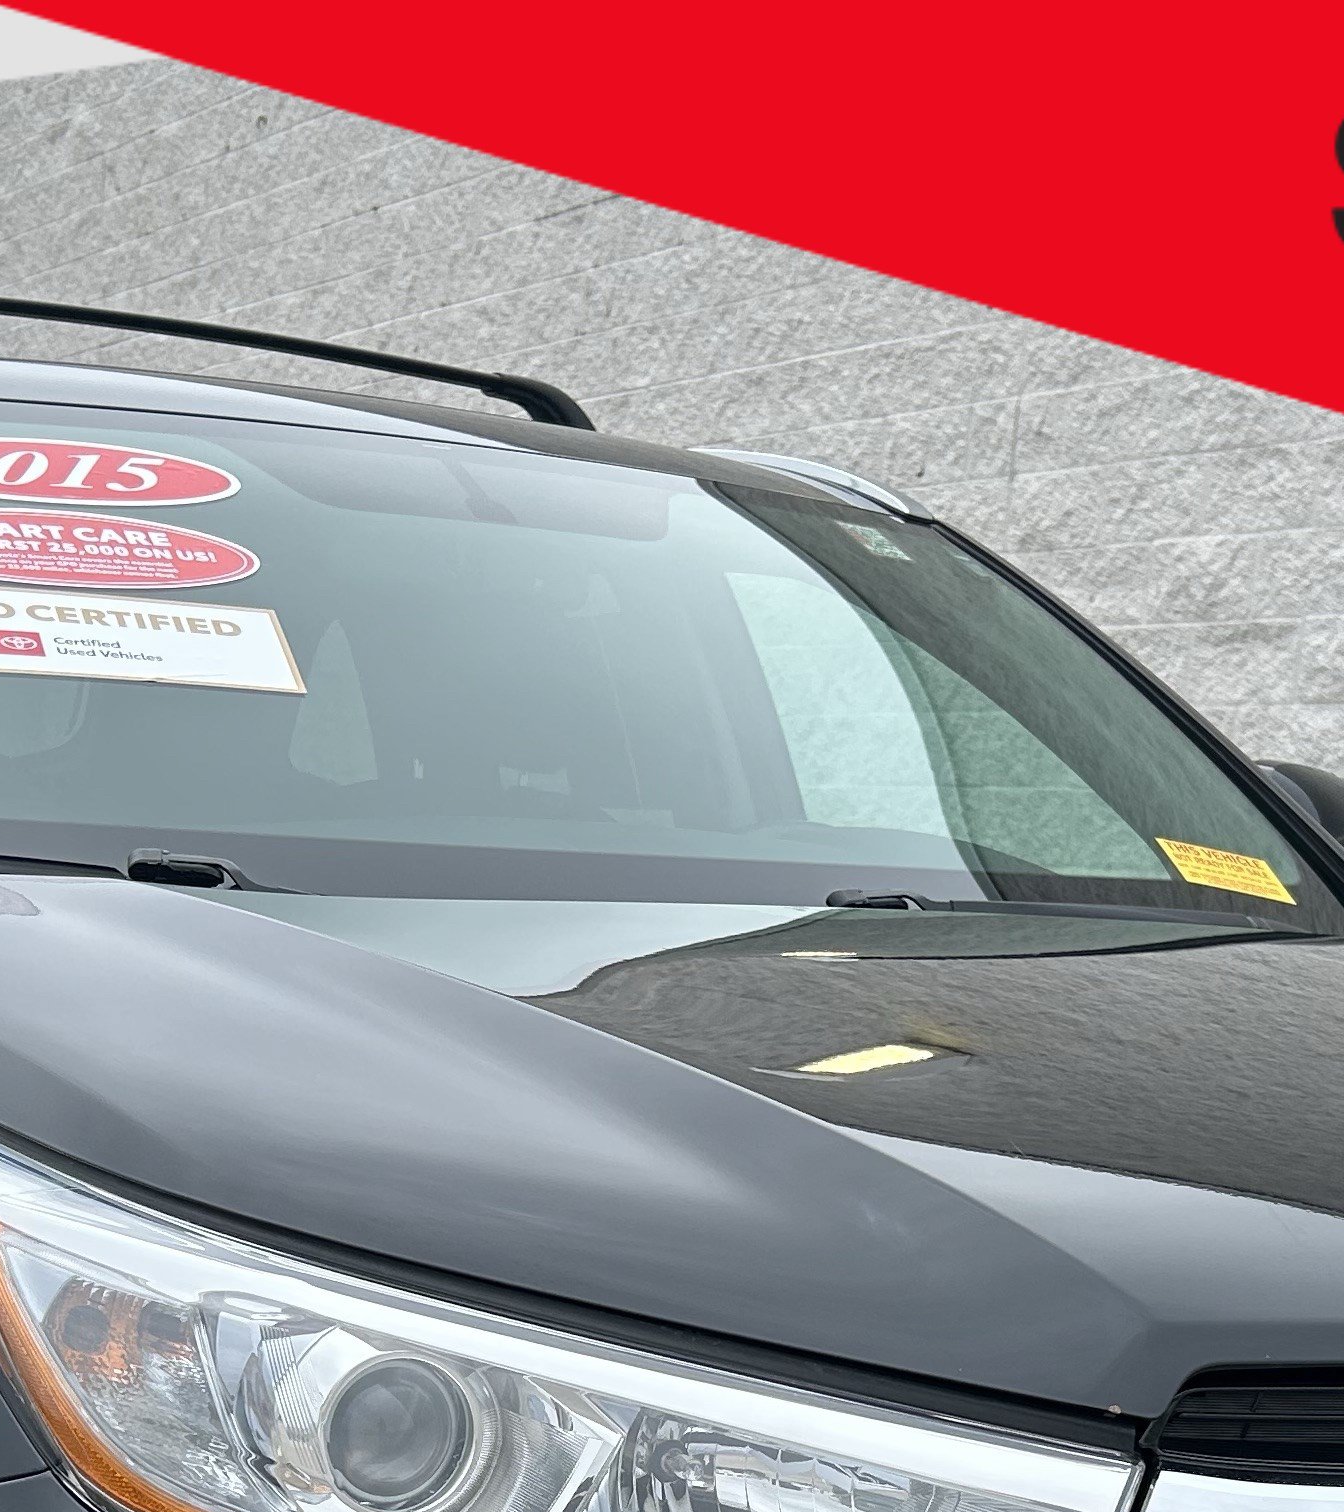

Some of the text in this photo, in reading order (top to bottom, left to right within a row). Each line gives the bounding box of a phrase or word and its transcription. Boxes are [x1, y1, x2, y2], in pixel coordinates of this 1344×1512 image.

[72, 527, 172, 547] CARE
[47, 541, 129, 557] 25,000
[132, 547, 174, 561] ON
[175, 549, 218, 563] US!
[25, 604, 242, 638] CERTIFIED
[53, 636, 122, 649] Certified
[56, 646, 164, 662] Used Vehicles
[1164, 840, 1264, 870] THIS VEHICLE
